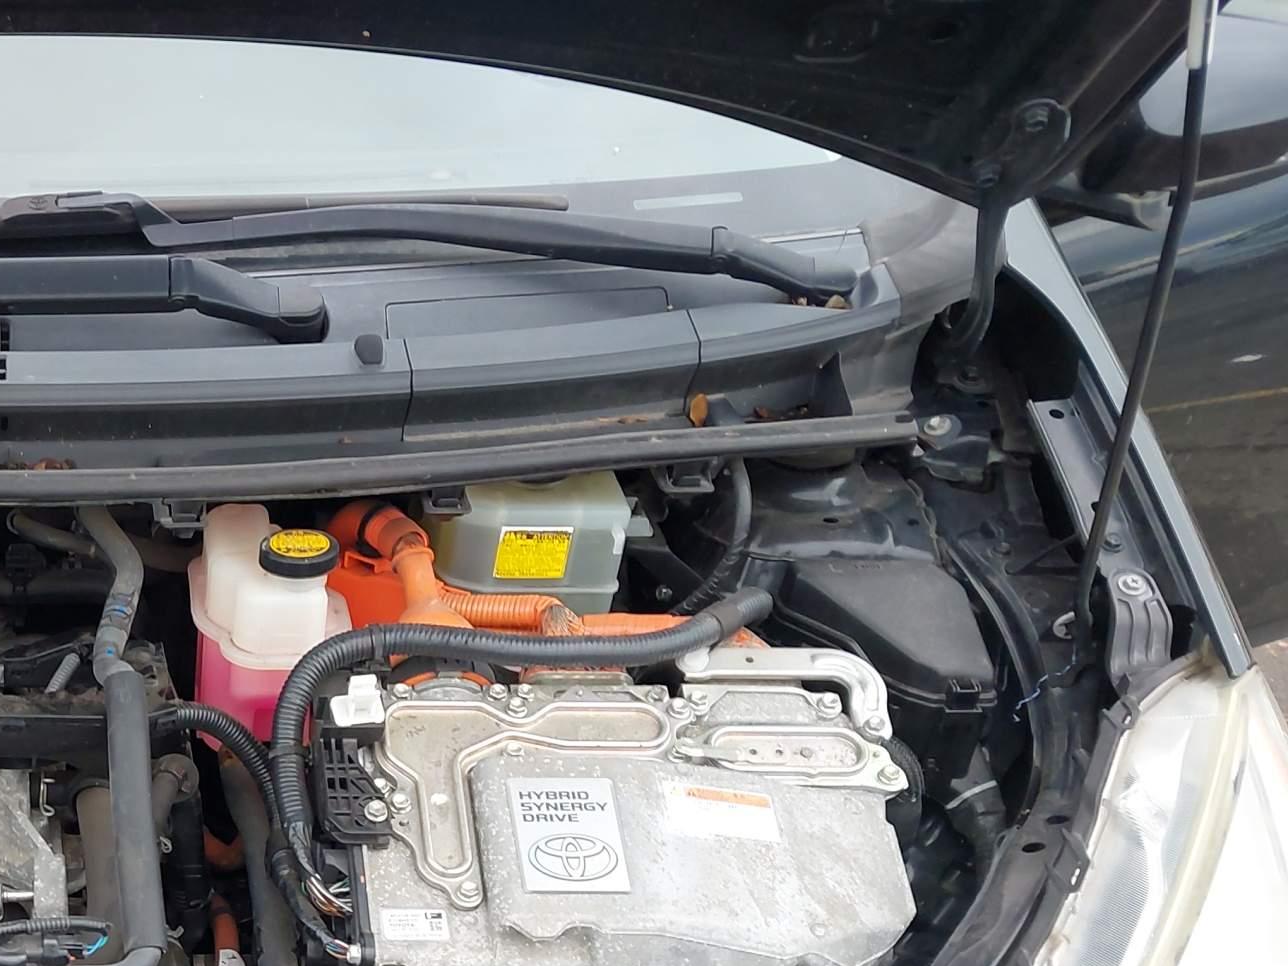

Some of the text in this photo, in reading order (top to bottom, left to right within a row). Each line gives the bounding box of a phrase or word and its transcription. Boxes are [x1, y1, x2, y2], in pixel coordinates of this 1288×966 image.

[519, 791, 589, 800] HYBRID
[520, 802, 608, 811] SYNERGY
[522, 813, 580, 822] DRIVE
